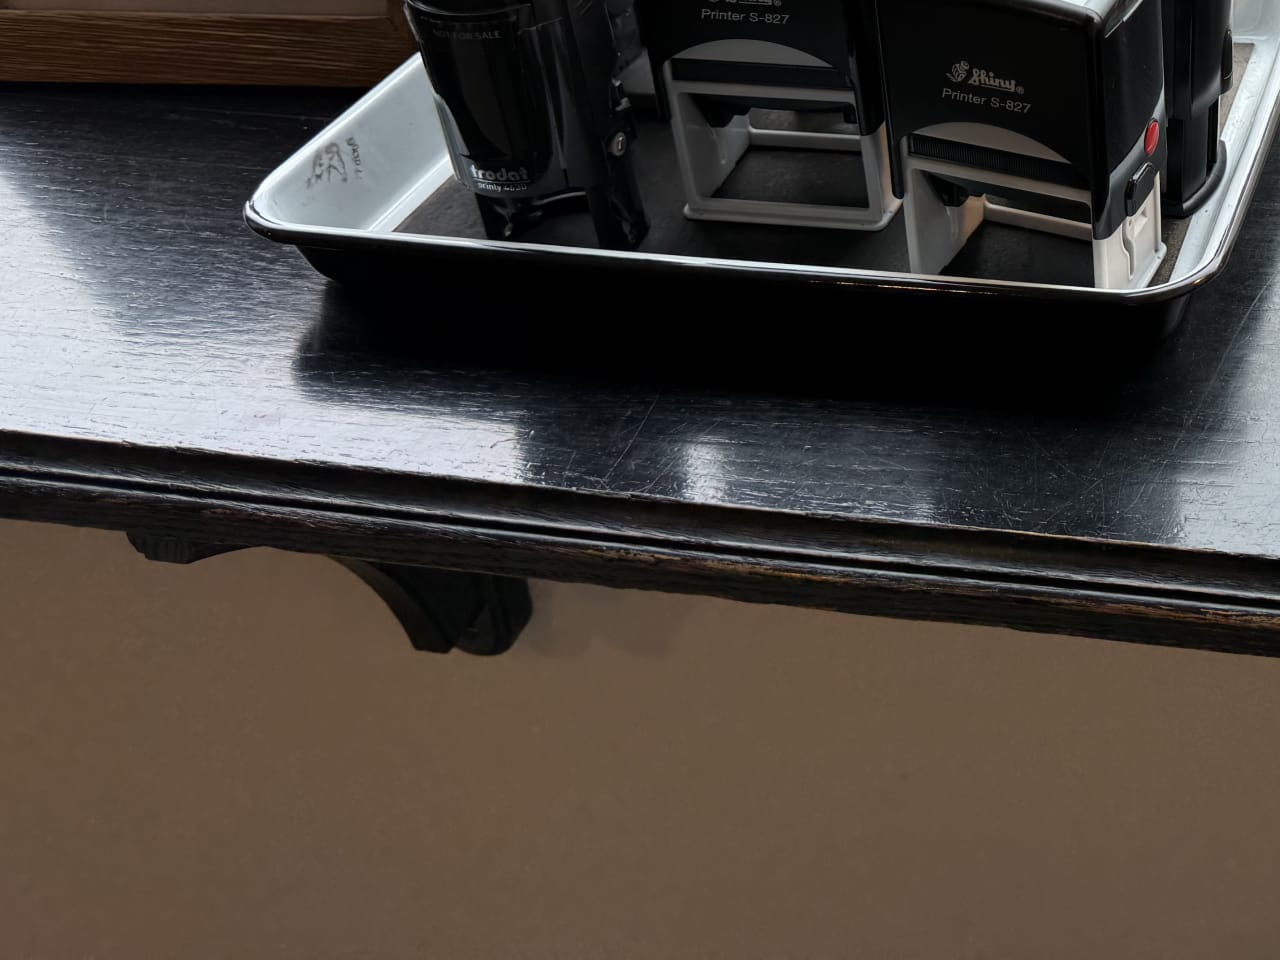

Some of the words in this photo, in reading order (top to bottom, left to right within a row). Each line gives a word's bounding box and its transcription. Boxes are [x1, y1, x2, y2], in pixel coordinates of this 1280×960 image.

[700, 8, 746, 22] Printer
[748, 11, 791, 25] S-827
[941, 87, 987, 107] Printer
[990, 95, 1032, 113] S-827
[470, 164, 528, 181] trodat
